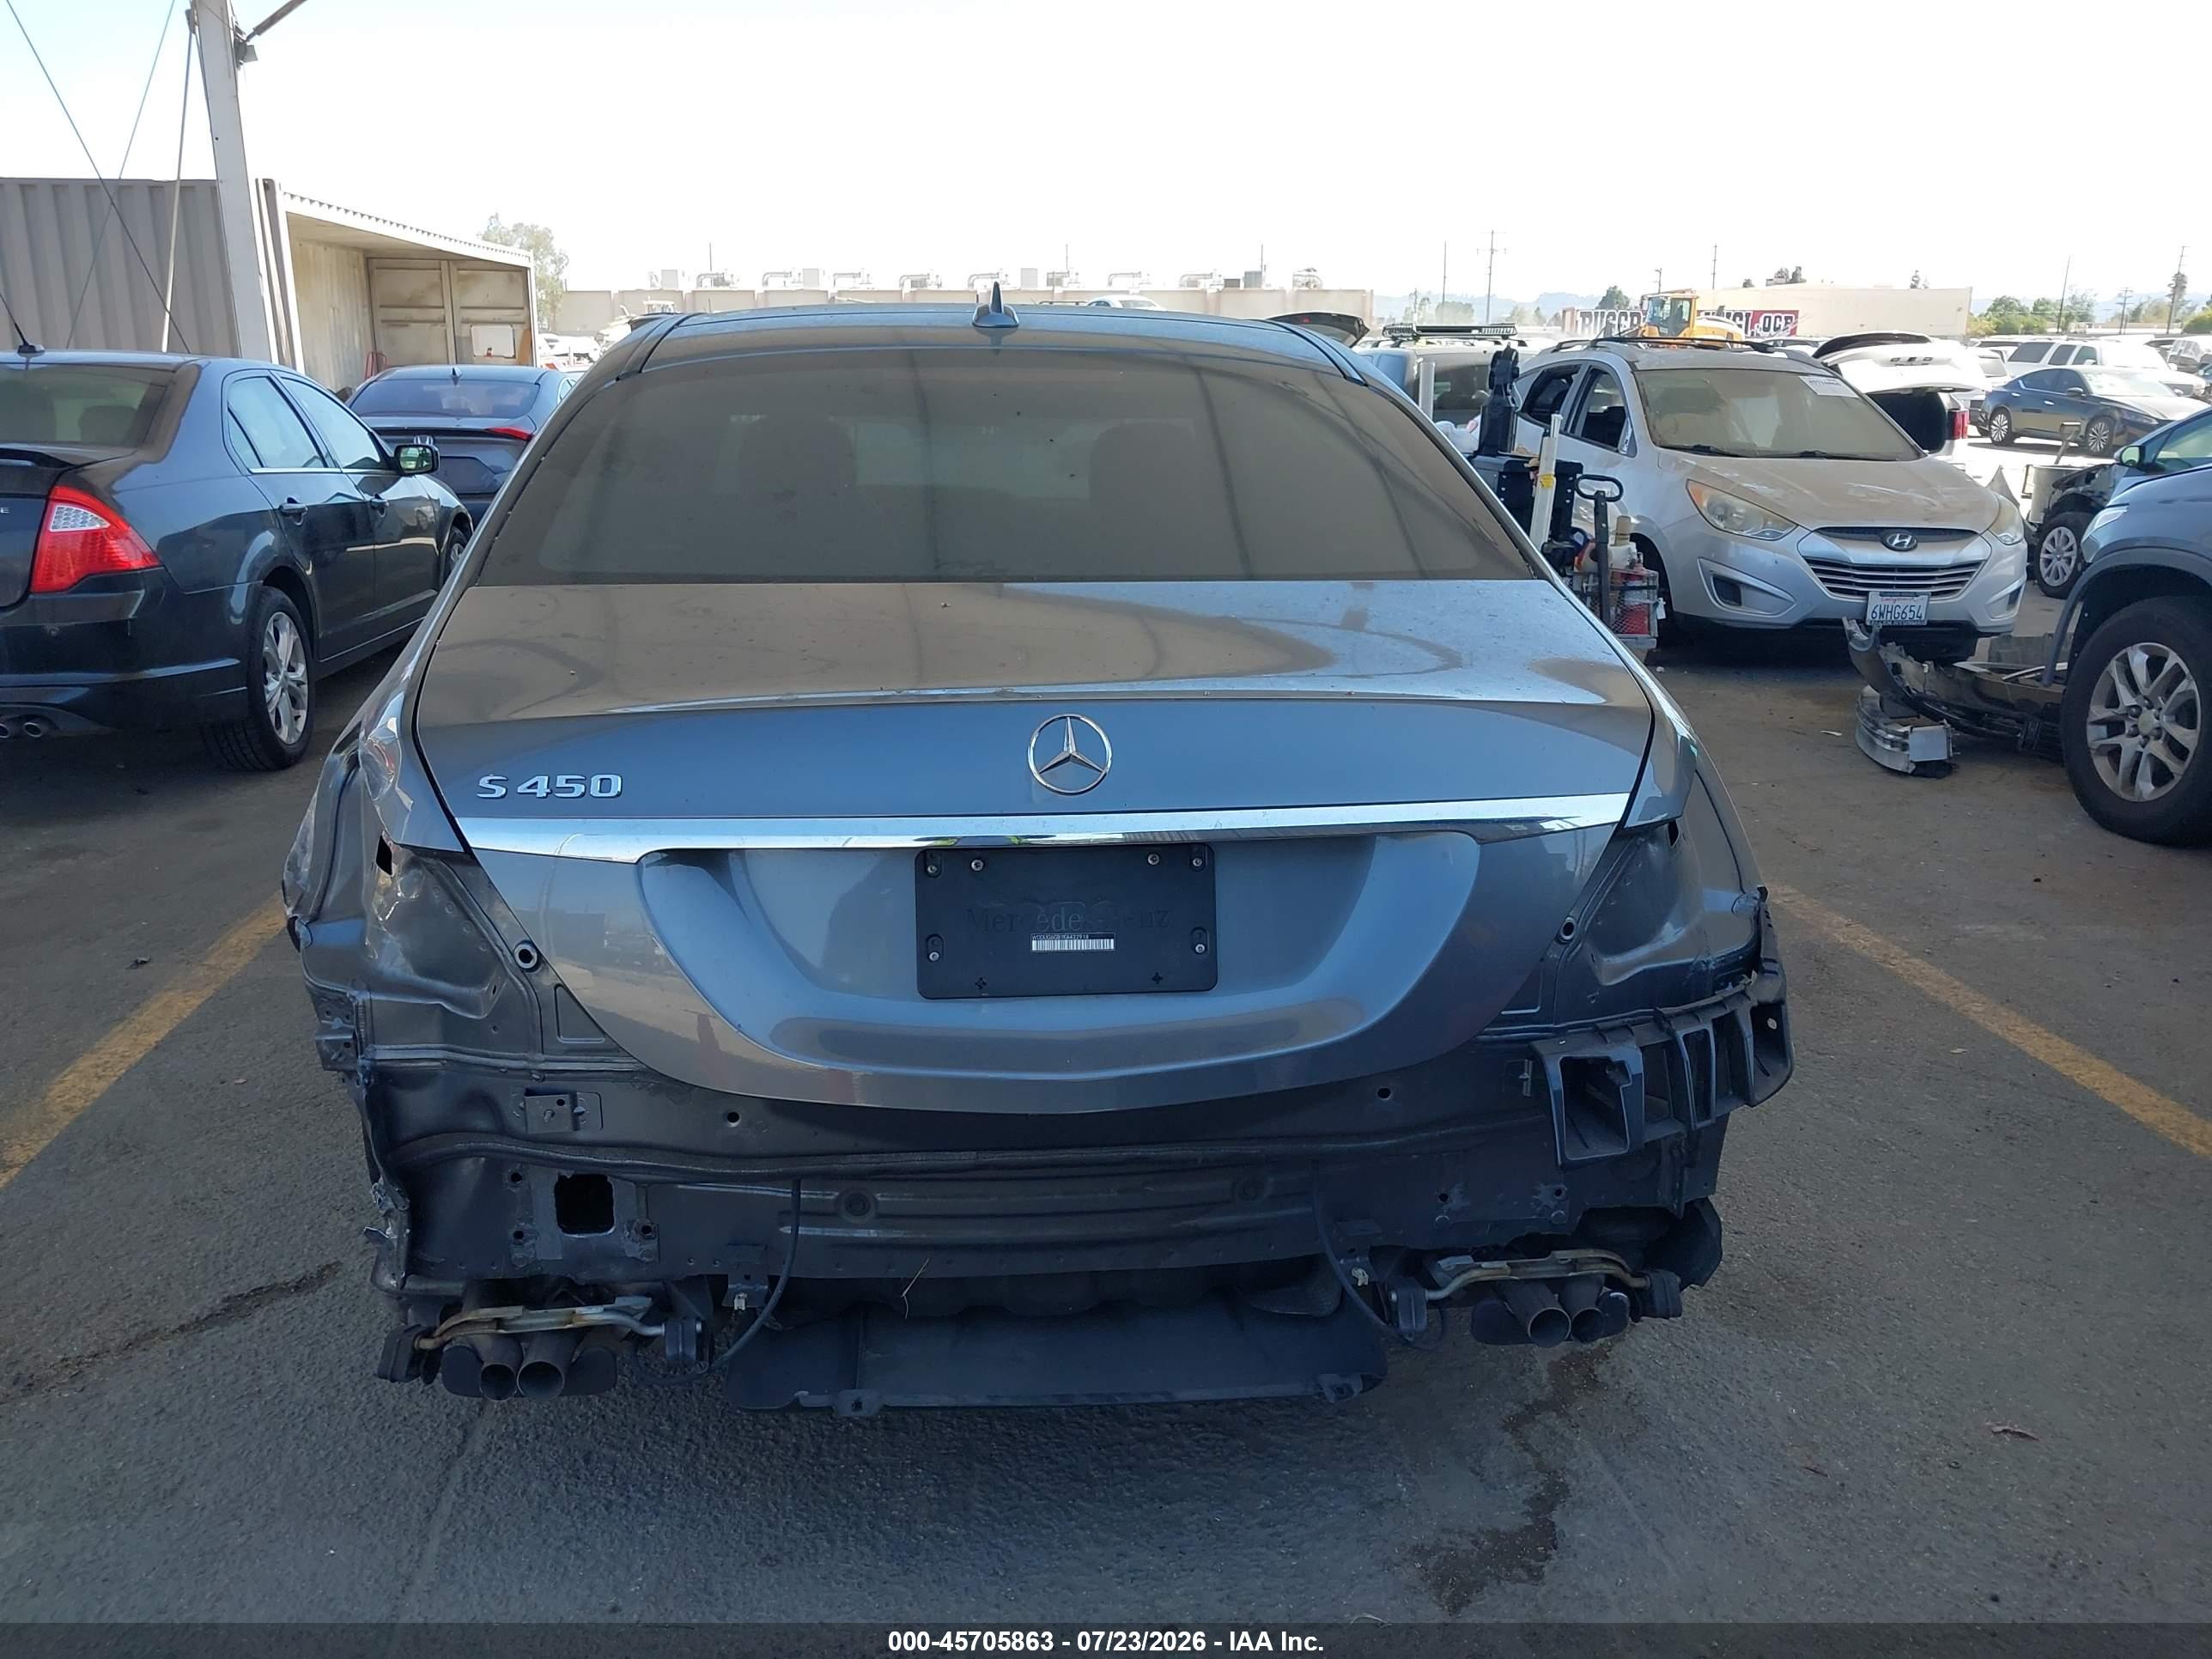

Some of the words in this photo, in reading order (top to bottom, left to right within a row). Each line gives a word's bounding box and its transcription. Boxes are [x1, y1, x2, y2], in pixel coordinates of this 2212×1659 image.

[1871, 605, 1923, 620] 6WHG654
[476, 775, 508, 799] S
[517, 775, 622, 799] 450
